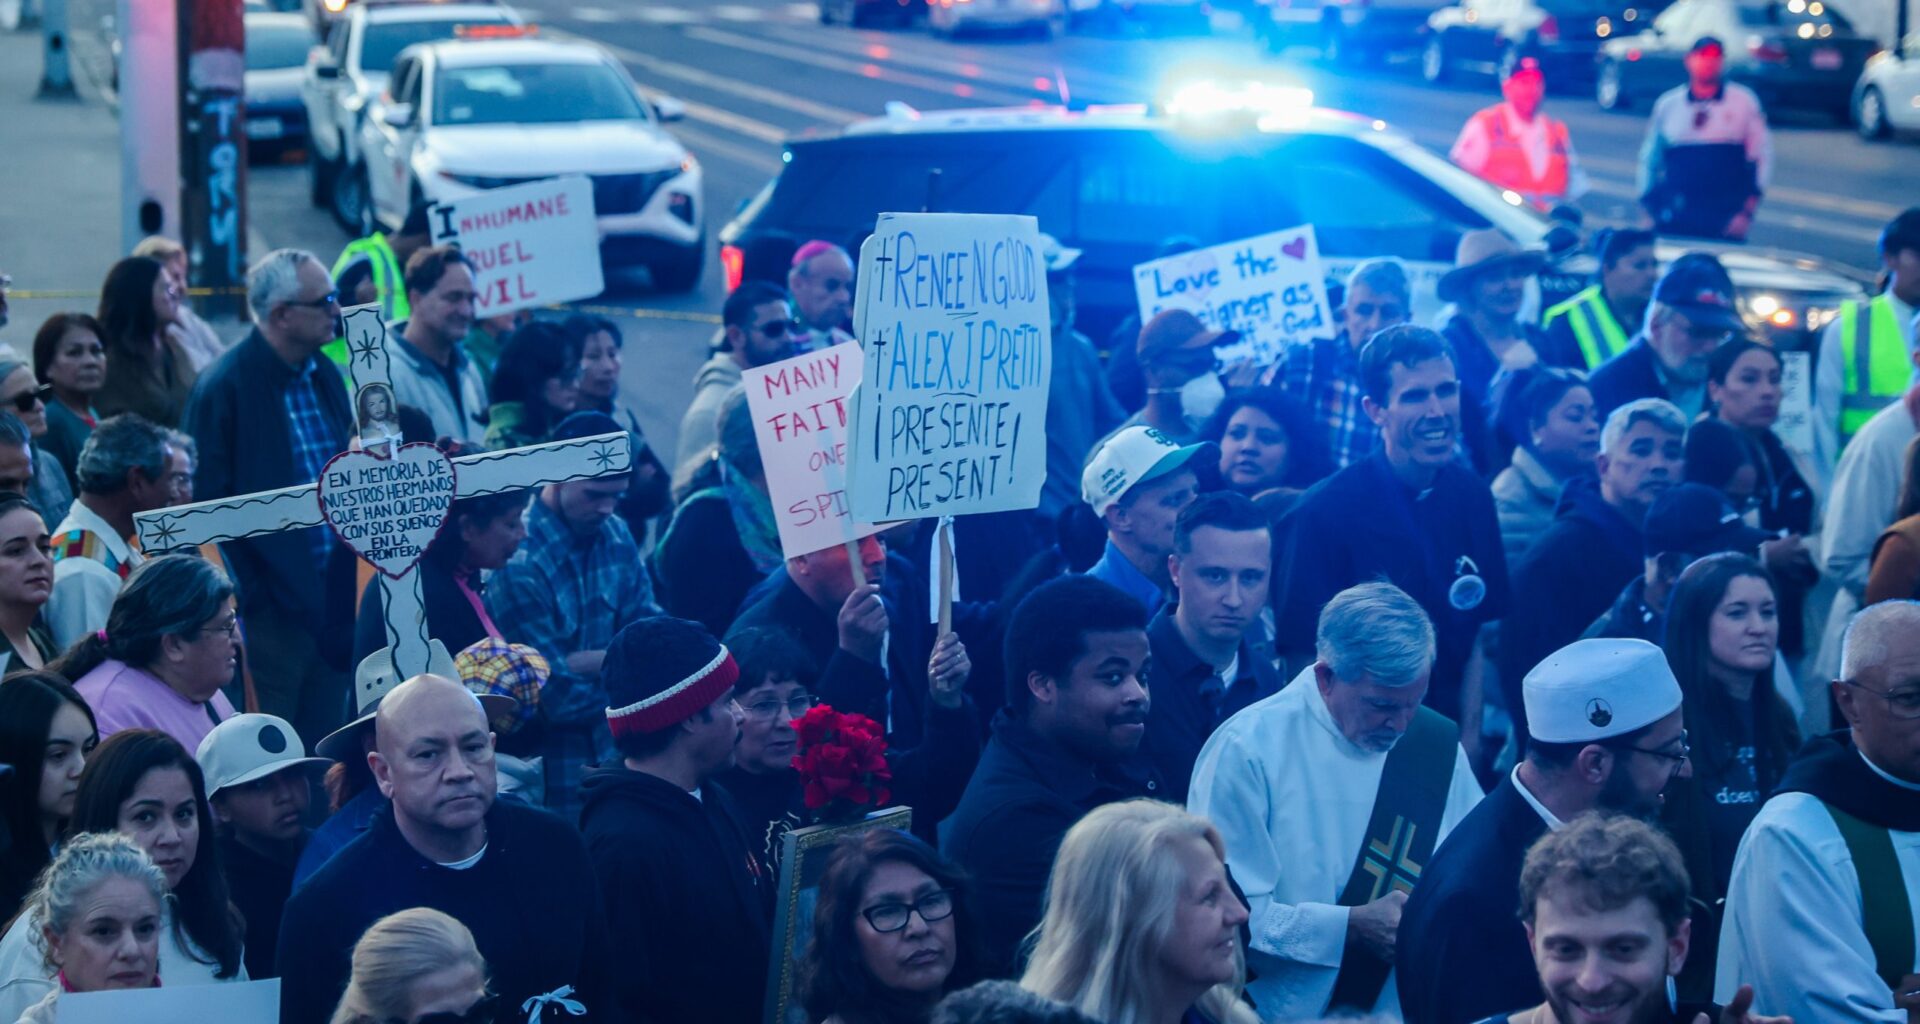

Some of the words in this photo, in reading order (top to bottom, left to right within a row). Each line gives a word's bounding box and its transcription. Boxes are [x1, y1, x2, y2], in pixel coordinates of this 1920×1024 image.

[435, 193, 571, 239] INHUMANE
[448, 240, 534, 274] RUEL
[894, 231, 968, 310] RENEE
[992, 236, 1036, 309] GOOD
[1233, 246, 1279, 279] the
[475, 273, 538, 308] VIL
[1282, 283, 1313, 306] as
[888, 320, 953, 391] ALEX
[978, 320, 1042, 394] PRETTI
[764, 354, 840, 399] MANY
[329, 470, 351, 488] EN
[360, 462, 424, 484] MEMORIA
[428, 459, 447, 477] DE
[322, 485, 385, 511] NUESTROS
[386, 475, 454, 501] HERMANOS
[330, 508, 361, 525] QUE
[363, 503, 391, 520] HAN
[394, 494, 451, 515] QUEDADO
[789, 490, 849, 526] SPI
[341, 523, 370, 540] CON
[371, 520, 394, 536] SUS
[396, 514, 442, 533] SUEÑOS
[371, 537, 389, 550] EN
[393, 533, 410, 546] LA
[364, 545, 422, 561] FRONTERA
